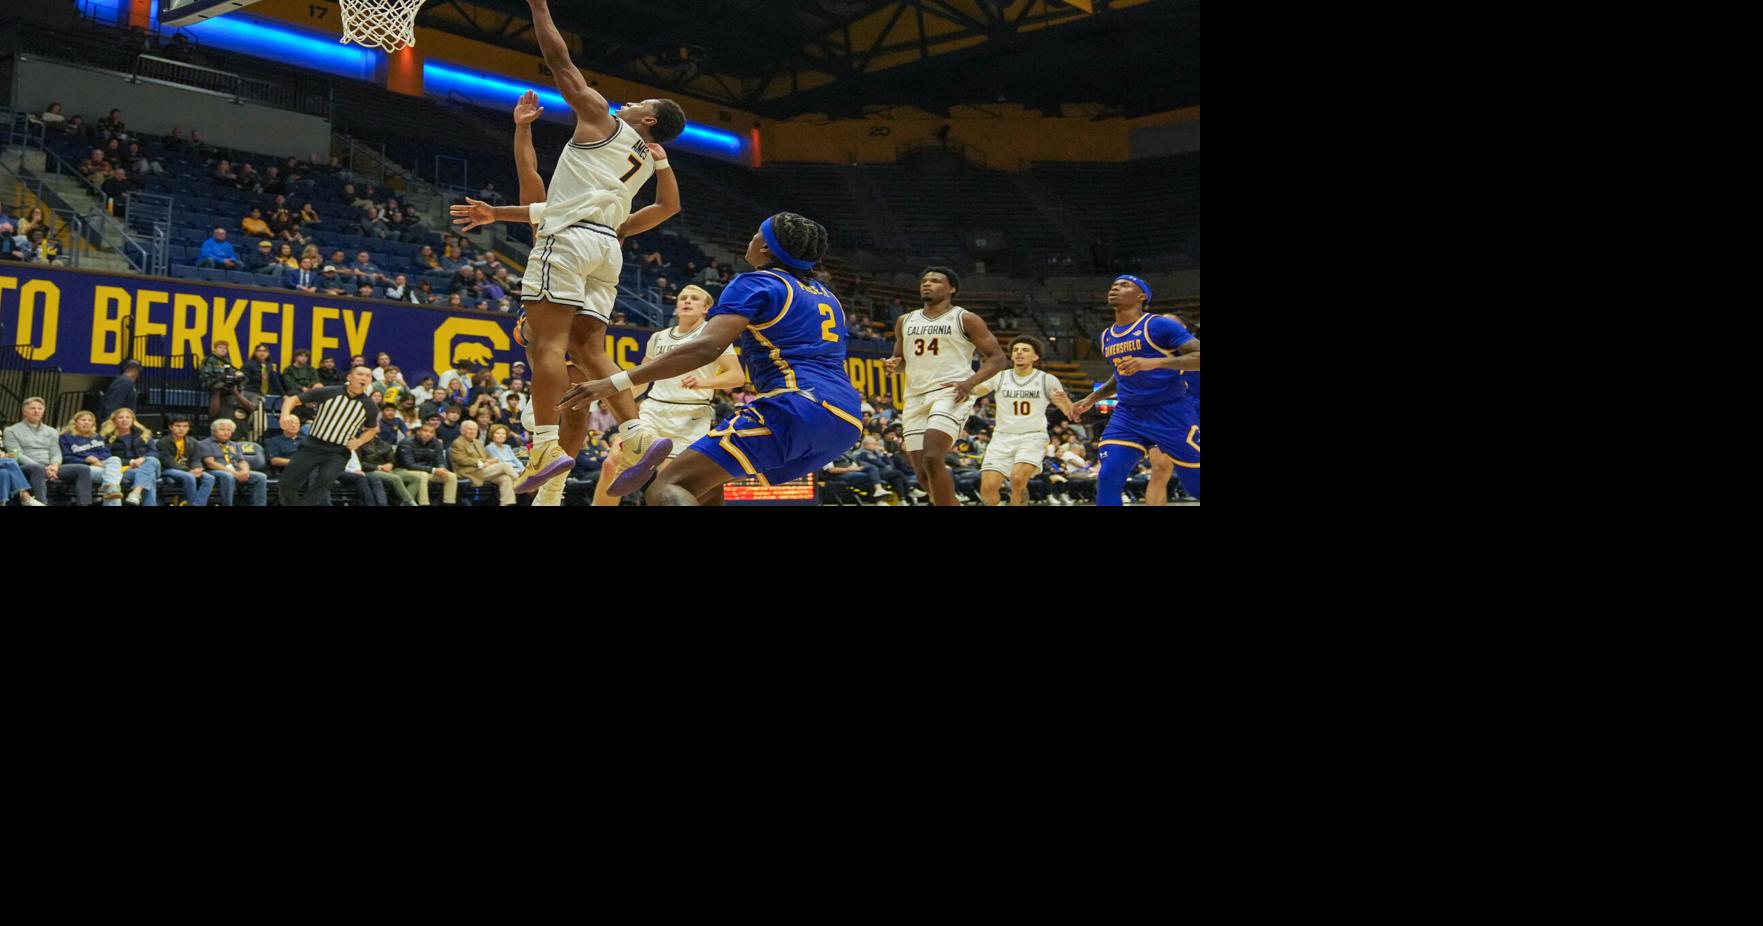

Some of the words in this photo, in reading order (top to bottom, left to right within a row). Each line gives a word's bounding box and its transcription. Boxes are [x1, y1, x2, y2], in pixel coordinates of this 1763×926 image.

[307, 4, 329, 19] 17
[868, 126, 890, 137] 20
[631, 139, 650, 160] AMES
[619, 154, 642, 183] 7
[817, 303, 839, 342] 2
[907, 325, 952, 336] CALIFORNIA
[914, 338, 939, 356] 34
[1002, 390, 1040, 399] CALIFORNIA
[1013, 400, 1031, 416] 10
